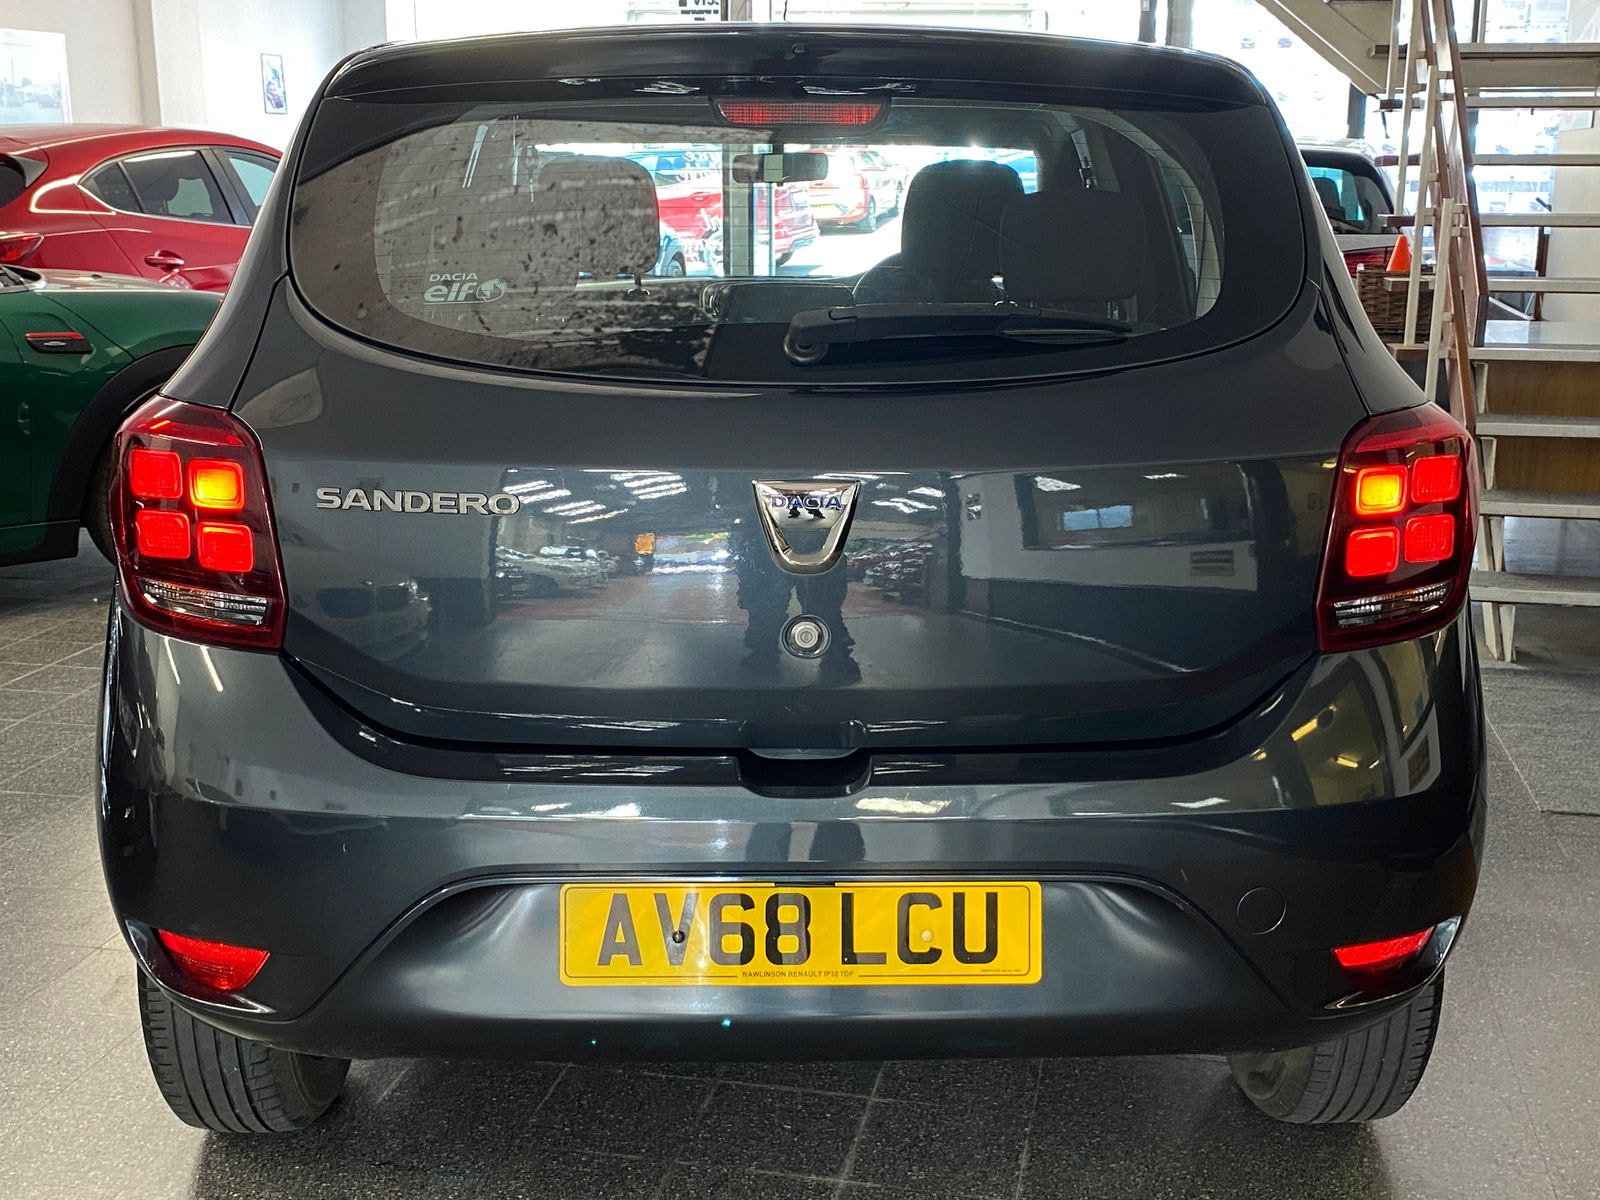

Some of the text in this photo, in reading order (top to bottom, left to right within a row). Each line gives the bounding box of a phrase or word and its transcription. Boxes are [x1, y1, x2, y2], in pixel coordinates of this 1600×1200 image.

[429, 272, 478, 282] DACIA
[423, 281, 477, 302] elf
[316, 487, 520, 515] SANDERO
[771, 496, 843, 510] DACIA
[597, 891, 998, 966] AV68 LCU
[742, 970, 787, 978] RAWLINSON
[788, 970, 822, 978] RENAULT
